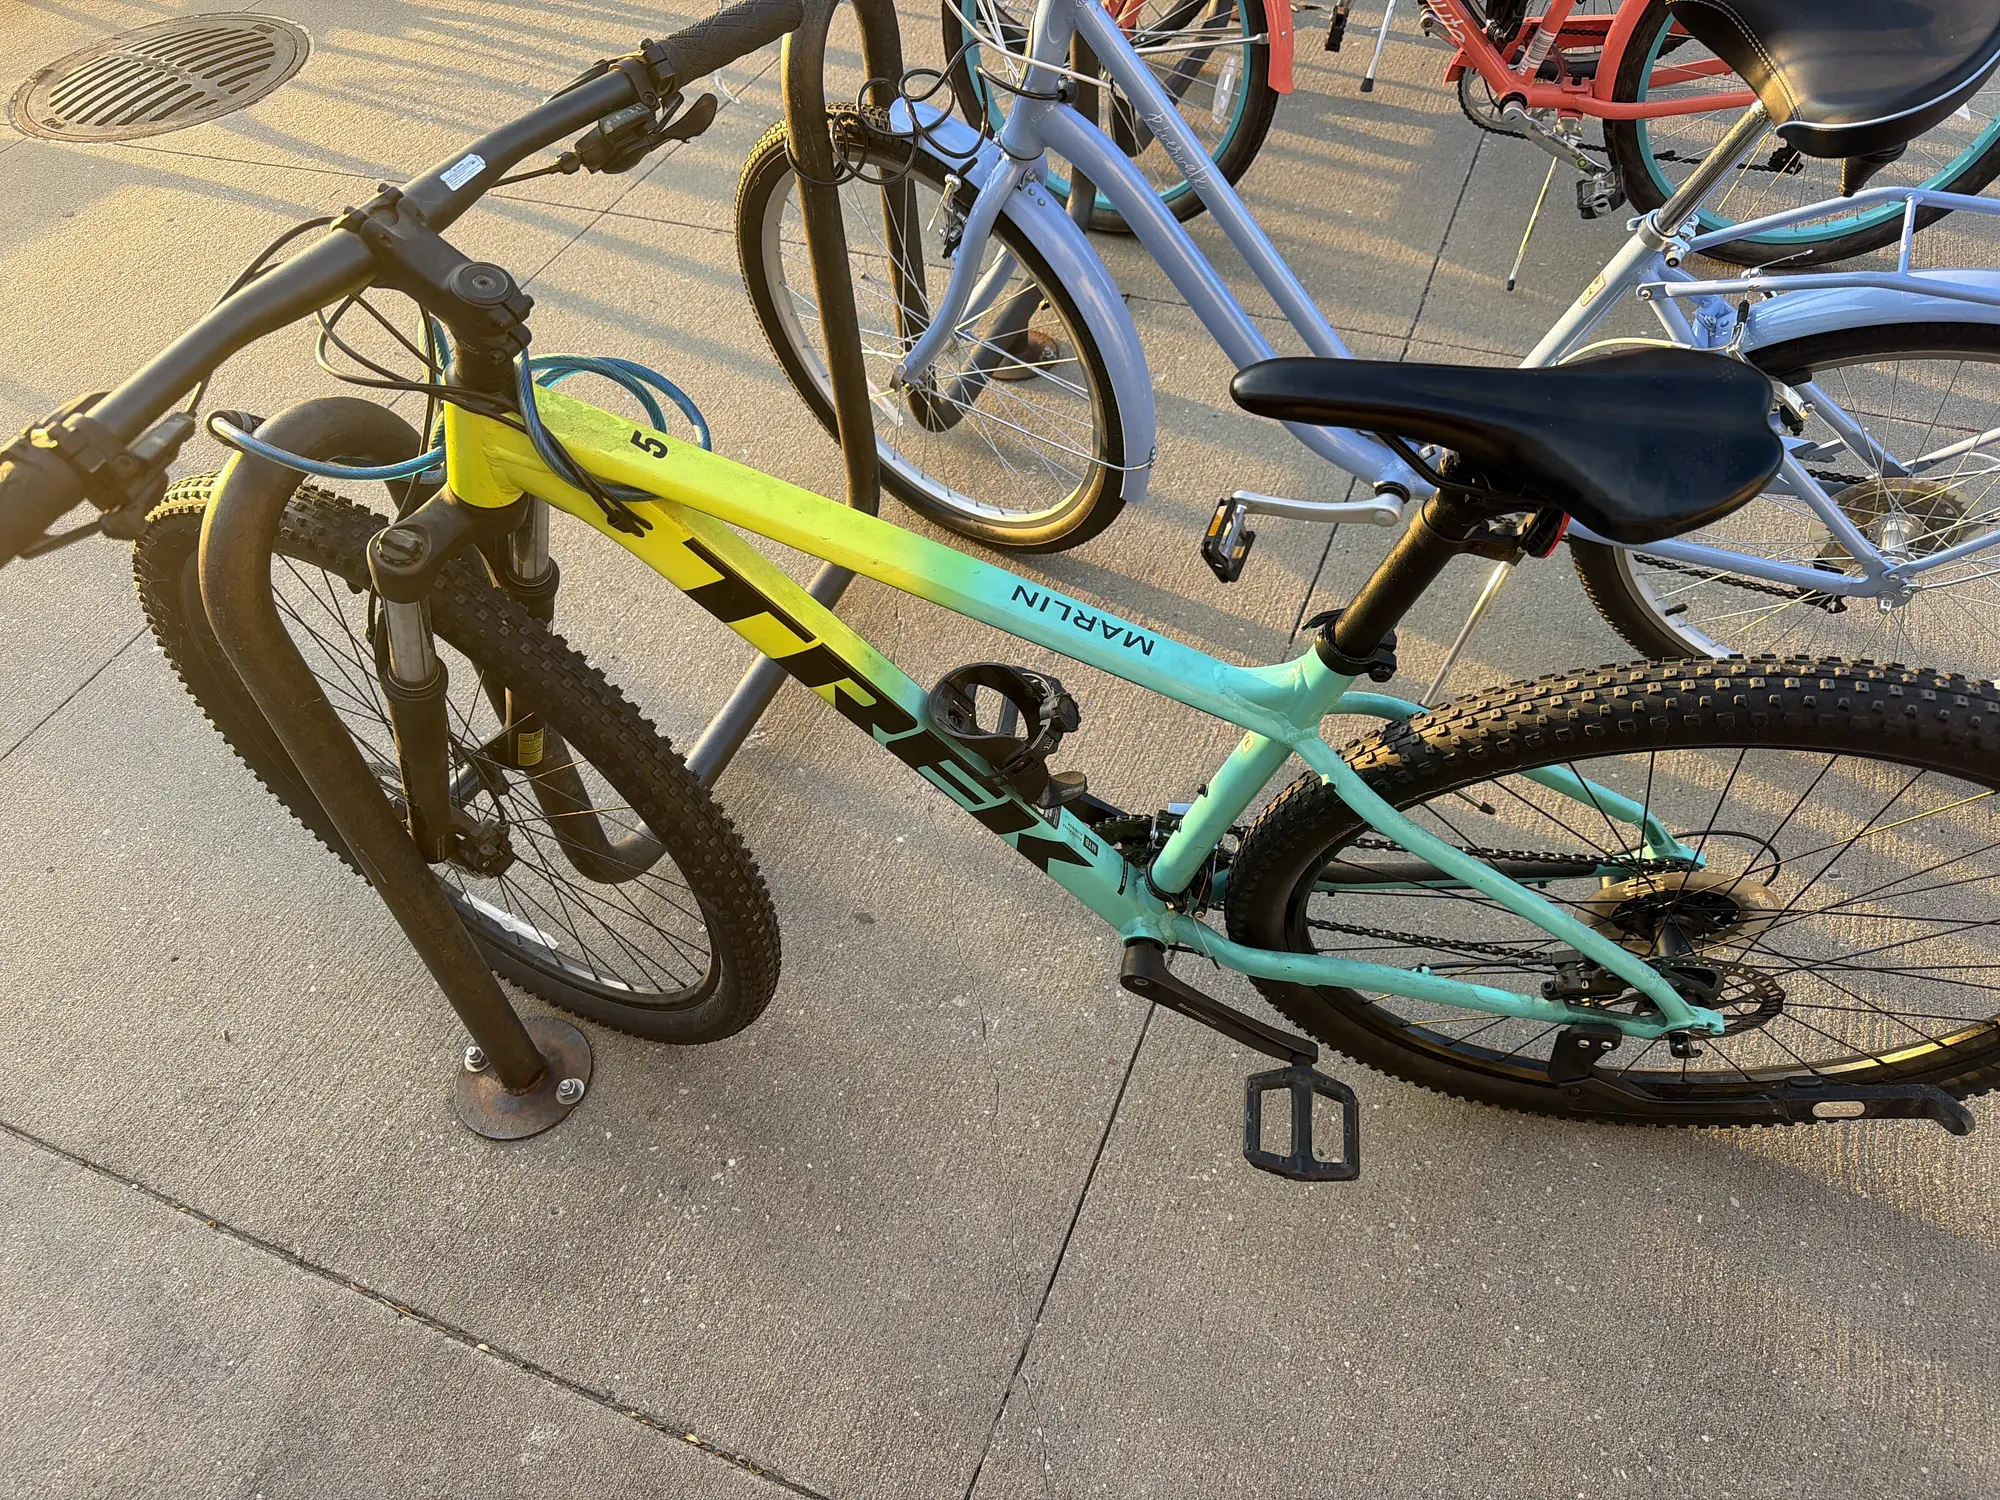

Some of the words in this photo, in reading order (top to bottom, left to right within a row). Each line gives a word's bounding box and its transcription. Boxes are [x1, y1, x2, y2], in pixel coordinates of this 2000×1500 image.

[1428, 0, 1466, 43] ute
[1143, 112, 1208, 189] Riverwalk
[630, 430, 668, 459] 5
[1011, 585, 1155, 656] MARLIN
[682, 537, 1094, 873] TREK
[1084, 837, 1098, 854] MTB
